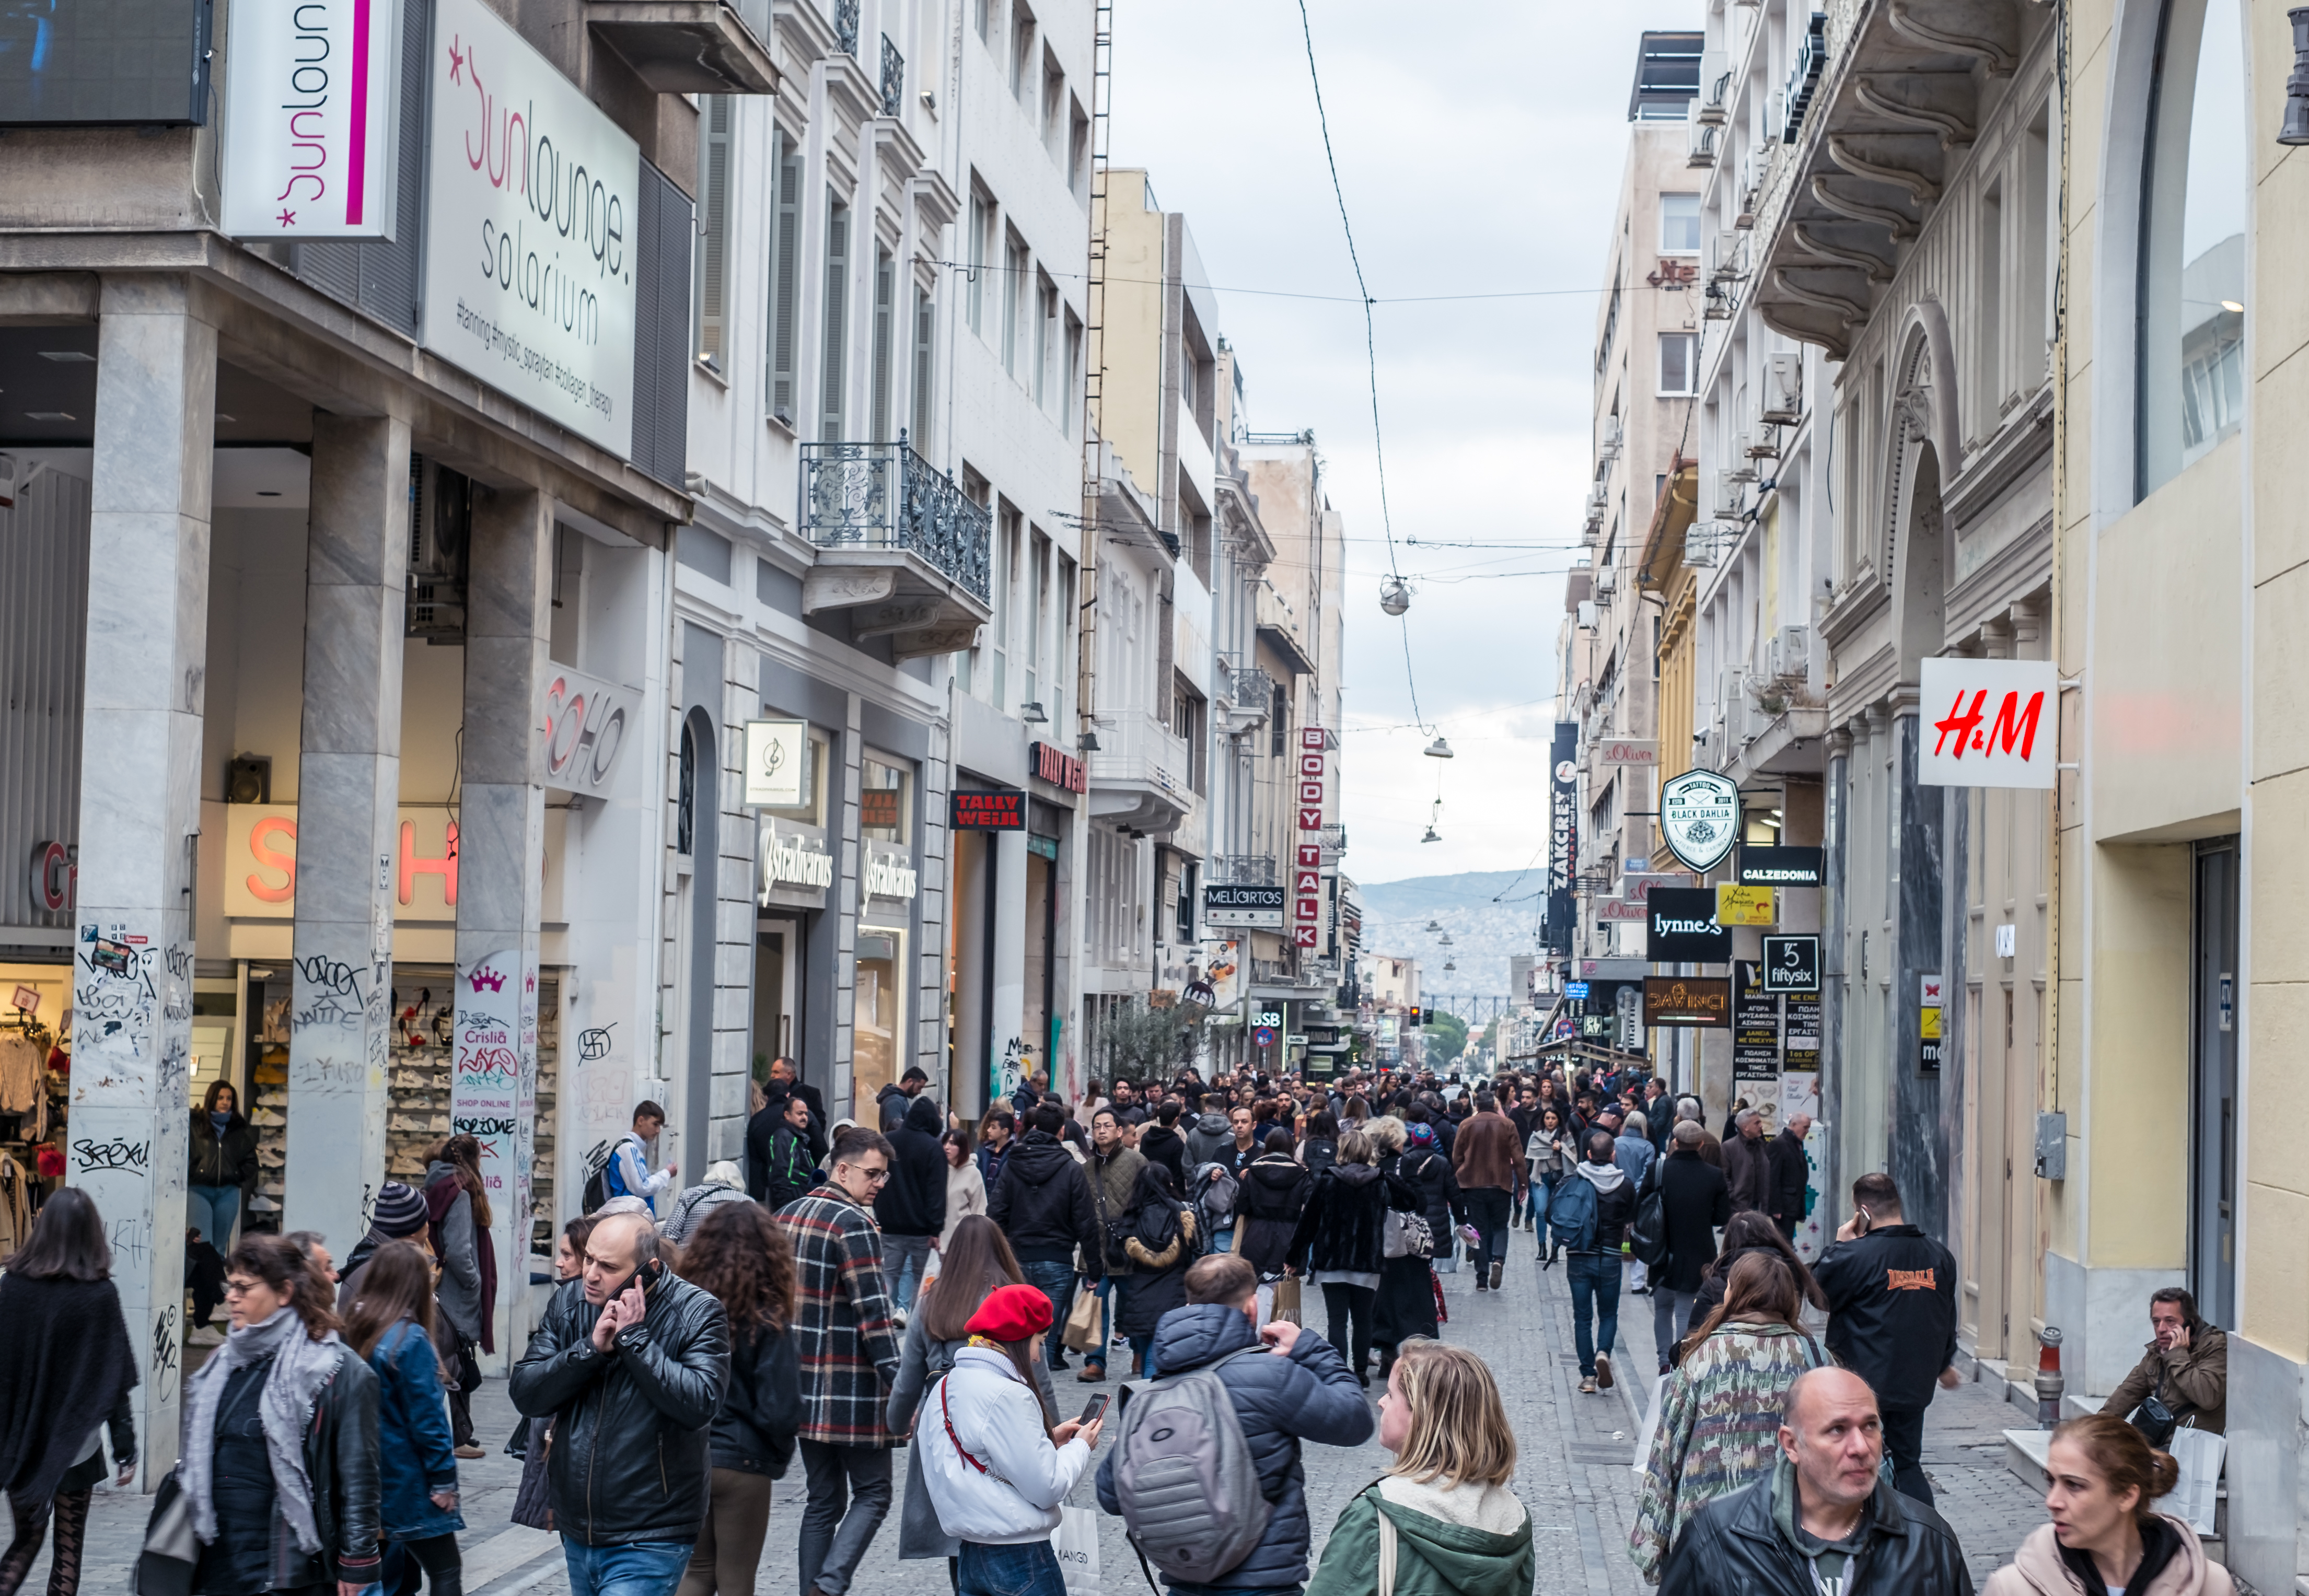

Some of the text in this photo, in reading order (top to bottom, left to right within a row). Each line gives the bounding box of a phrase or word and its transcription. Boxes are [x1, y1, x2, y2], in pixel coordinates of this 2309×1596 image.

[456, 296, 491, 350] #tanning
[1934, 689, 2045, 762] H&M
[1606, 743, 1653, 761] s.Oliver
[957, 795, 1019, 809] TALLY
[1672, 809, 1730, 819] BLACK DAHLIA
[1297, 732, 1322, 943] BODY TALK
[1678, 841, 1696, 853] FIERCE
[1706, 841, 1725, 852] CARING
[1743, 869, 1817, 881] CALZEDONIA
[1771, 968, 1812, 986] fiftysix
[480, 1100, 510, 1108] ONLINE
